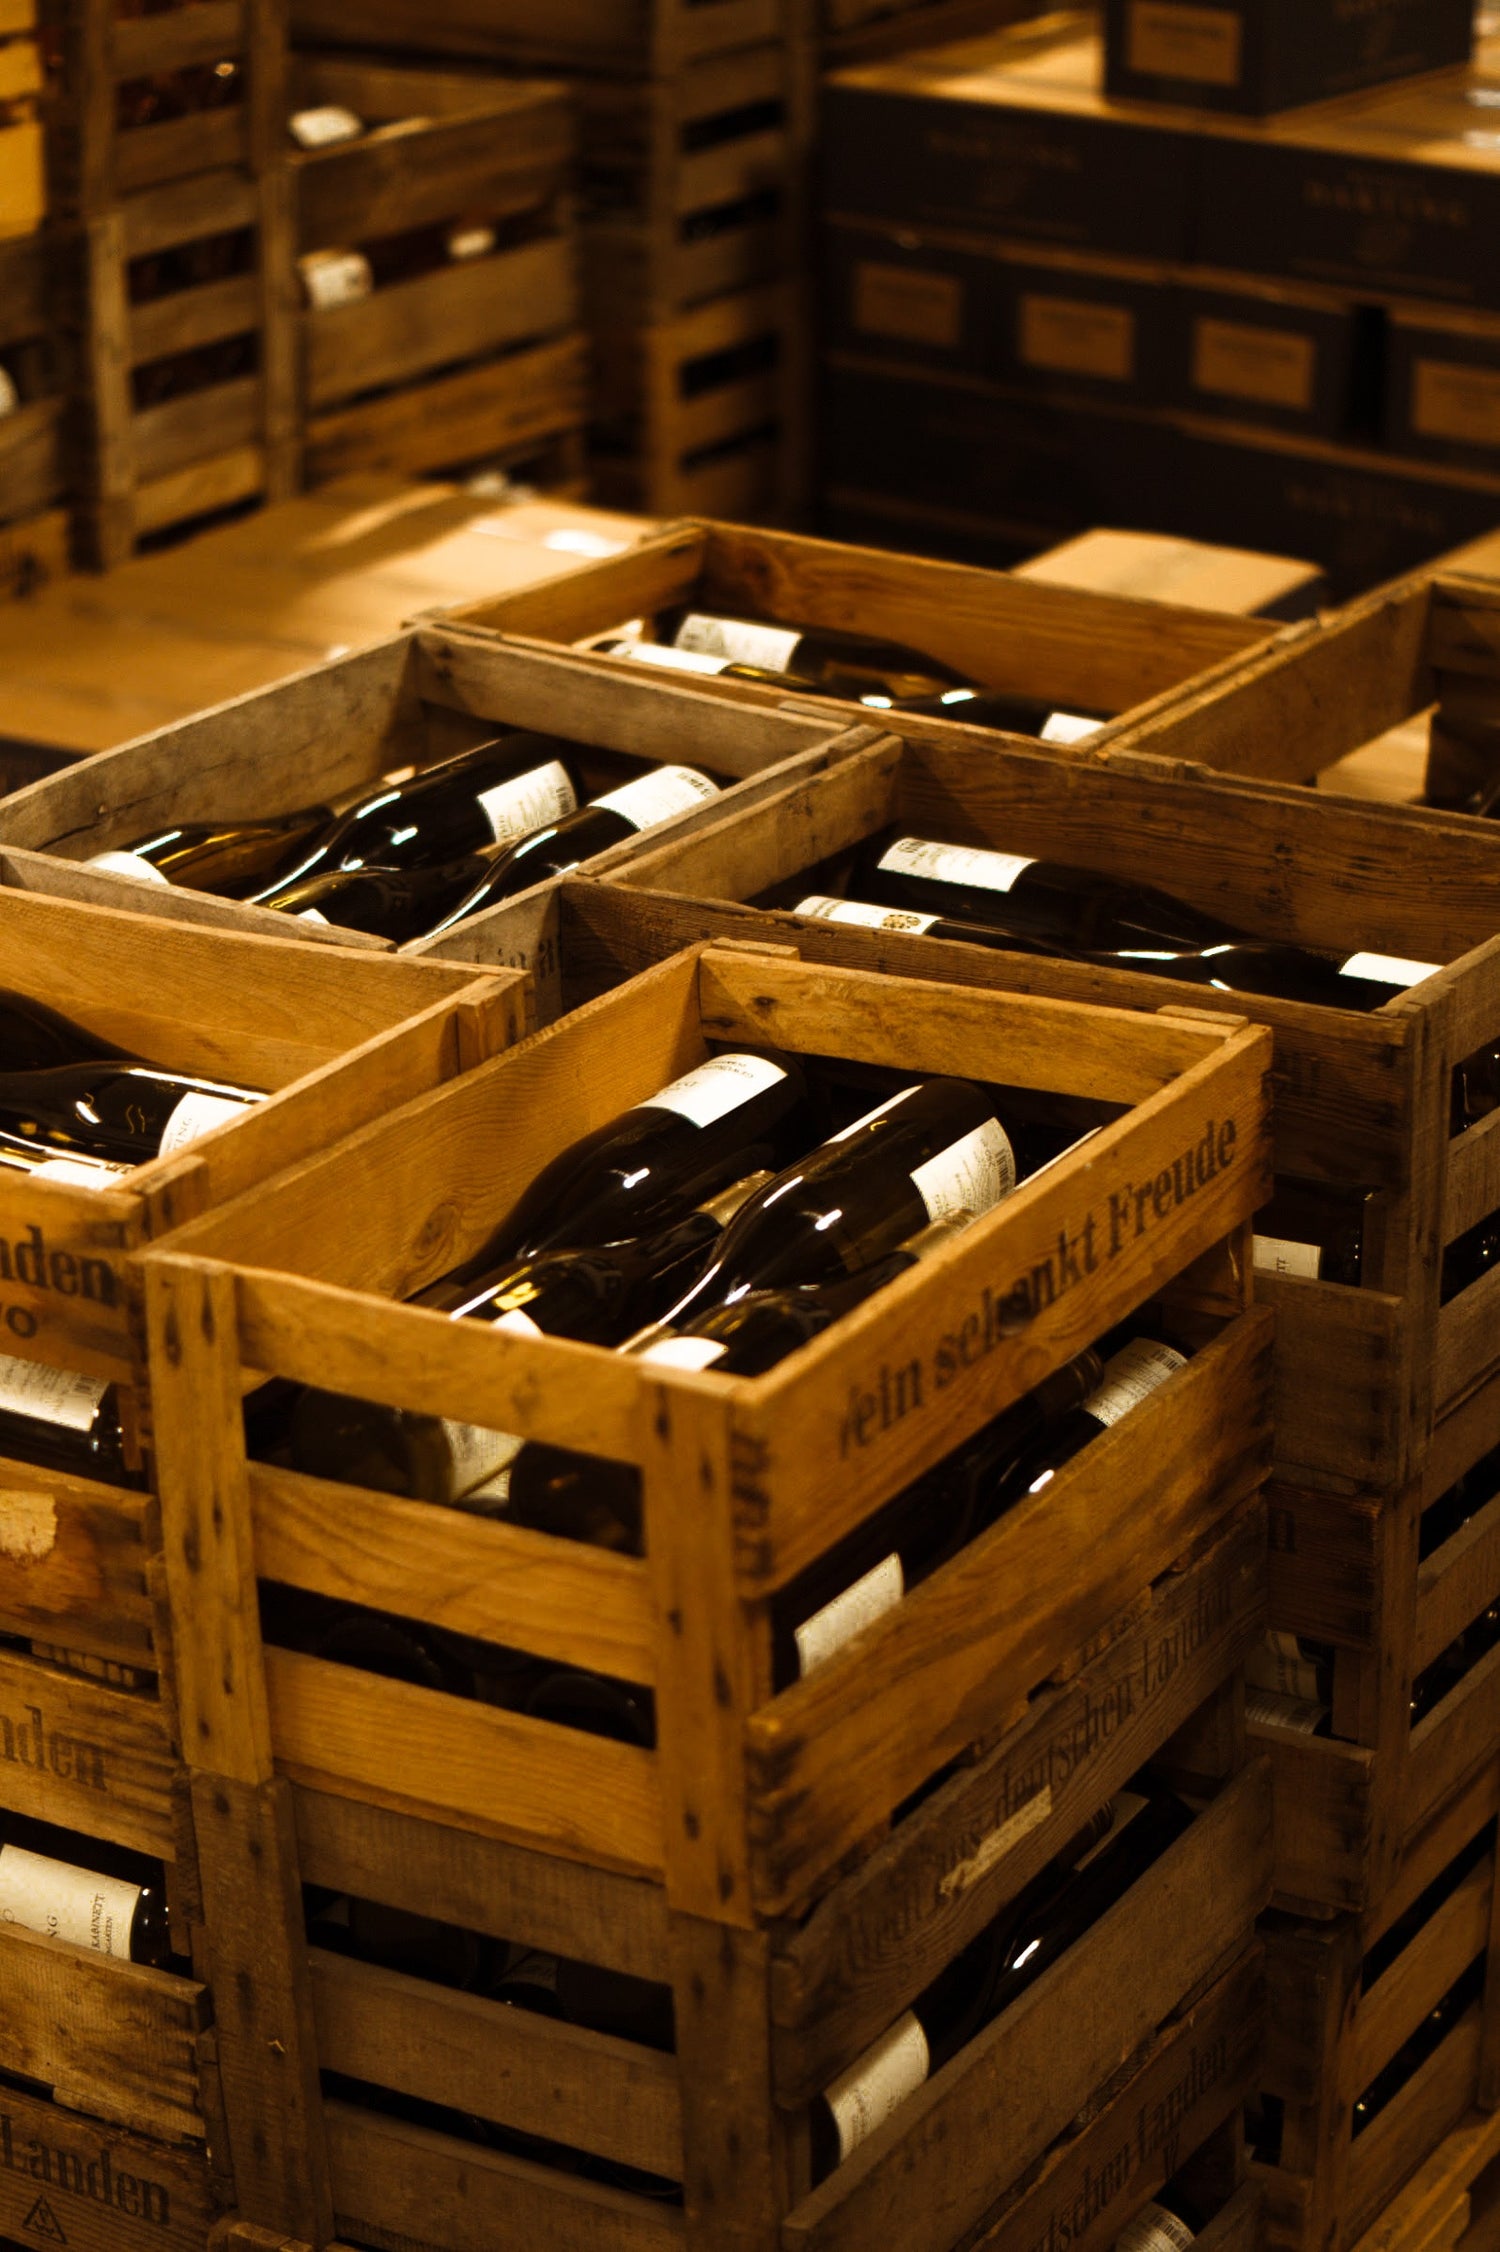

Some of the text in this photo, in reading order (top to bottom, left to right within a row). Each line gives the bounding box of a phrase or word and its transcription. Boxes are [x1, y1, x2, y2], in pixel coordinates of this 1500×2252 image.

[1108, 1118, 1237, 1260] Freude
[1142, 1582, 1232, 1698] Landen
[90, 1892, 106, 1950] KABINETT
[1137, 2036, 1228, 2166] Landen
[0, 2114, 171, 2227] Landen
